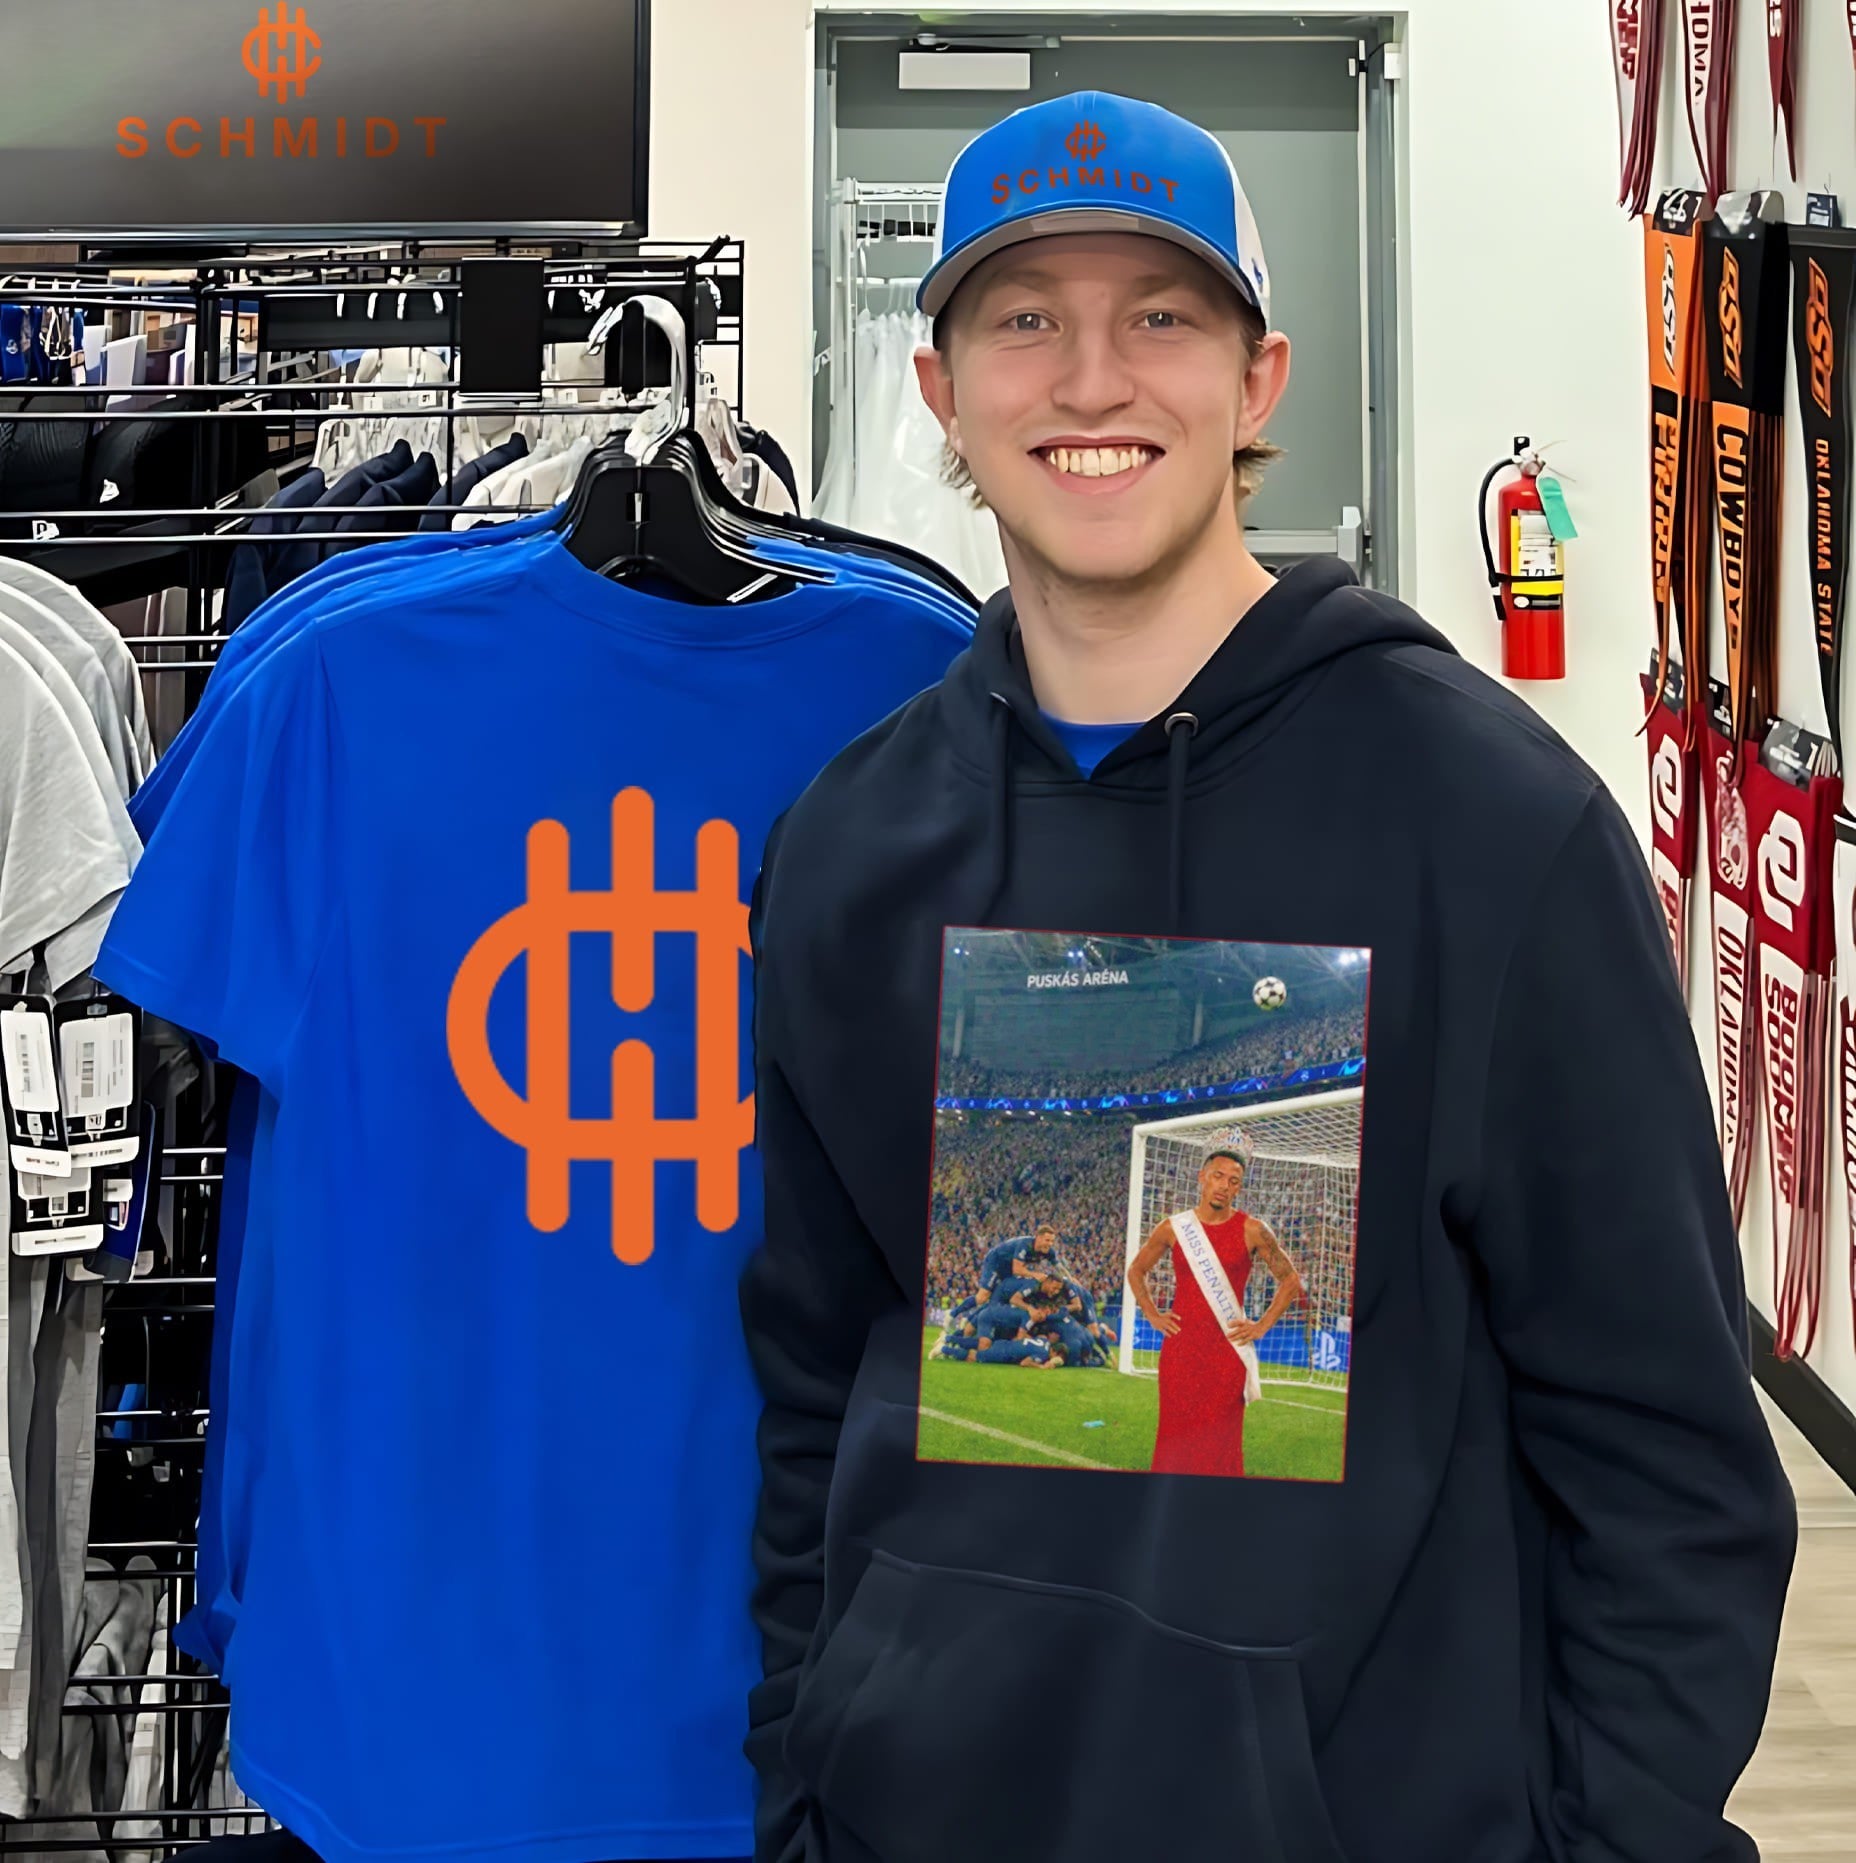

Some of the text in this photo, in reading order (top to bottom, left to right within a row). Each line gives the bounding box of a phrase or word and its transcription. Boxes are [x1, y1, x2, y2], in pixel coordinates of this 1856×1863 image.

[116, 117, 447, 159] SCHMIDT
[991, 167, 1179, 205] SCHMIDT
[1815, 438, 1833, 658] OKLAHOMA STATE
[1026, 968, 1129, 988] PUSKÁS ARÉNA
[1719, 926, 1745, 1144] OKLAHOMA
[1182, 1223, 1237, 1320] MISS PENALTY
